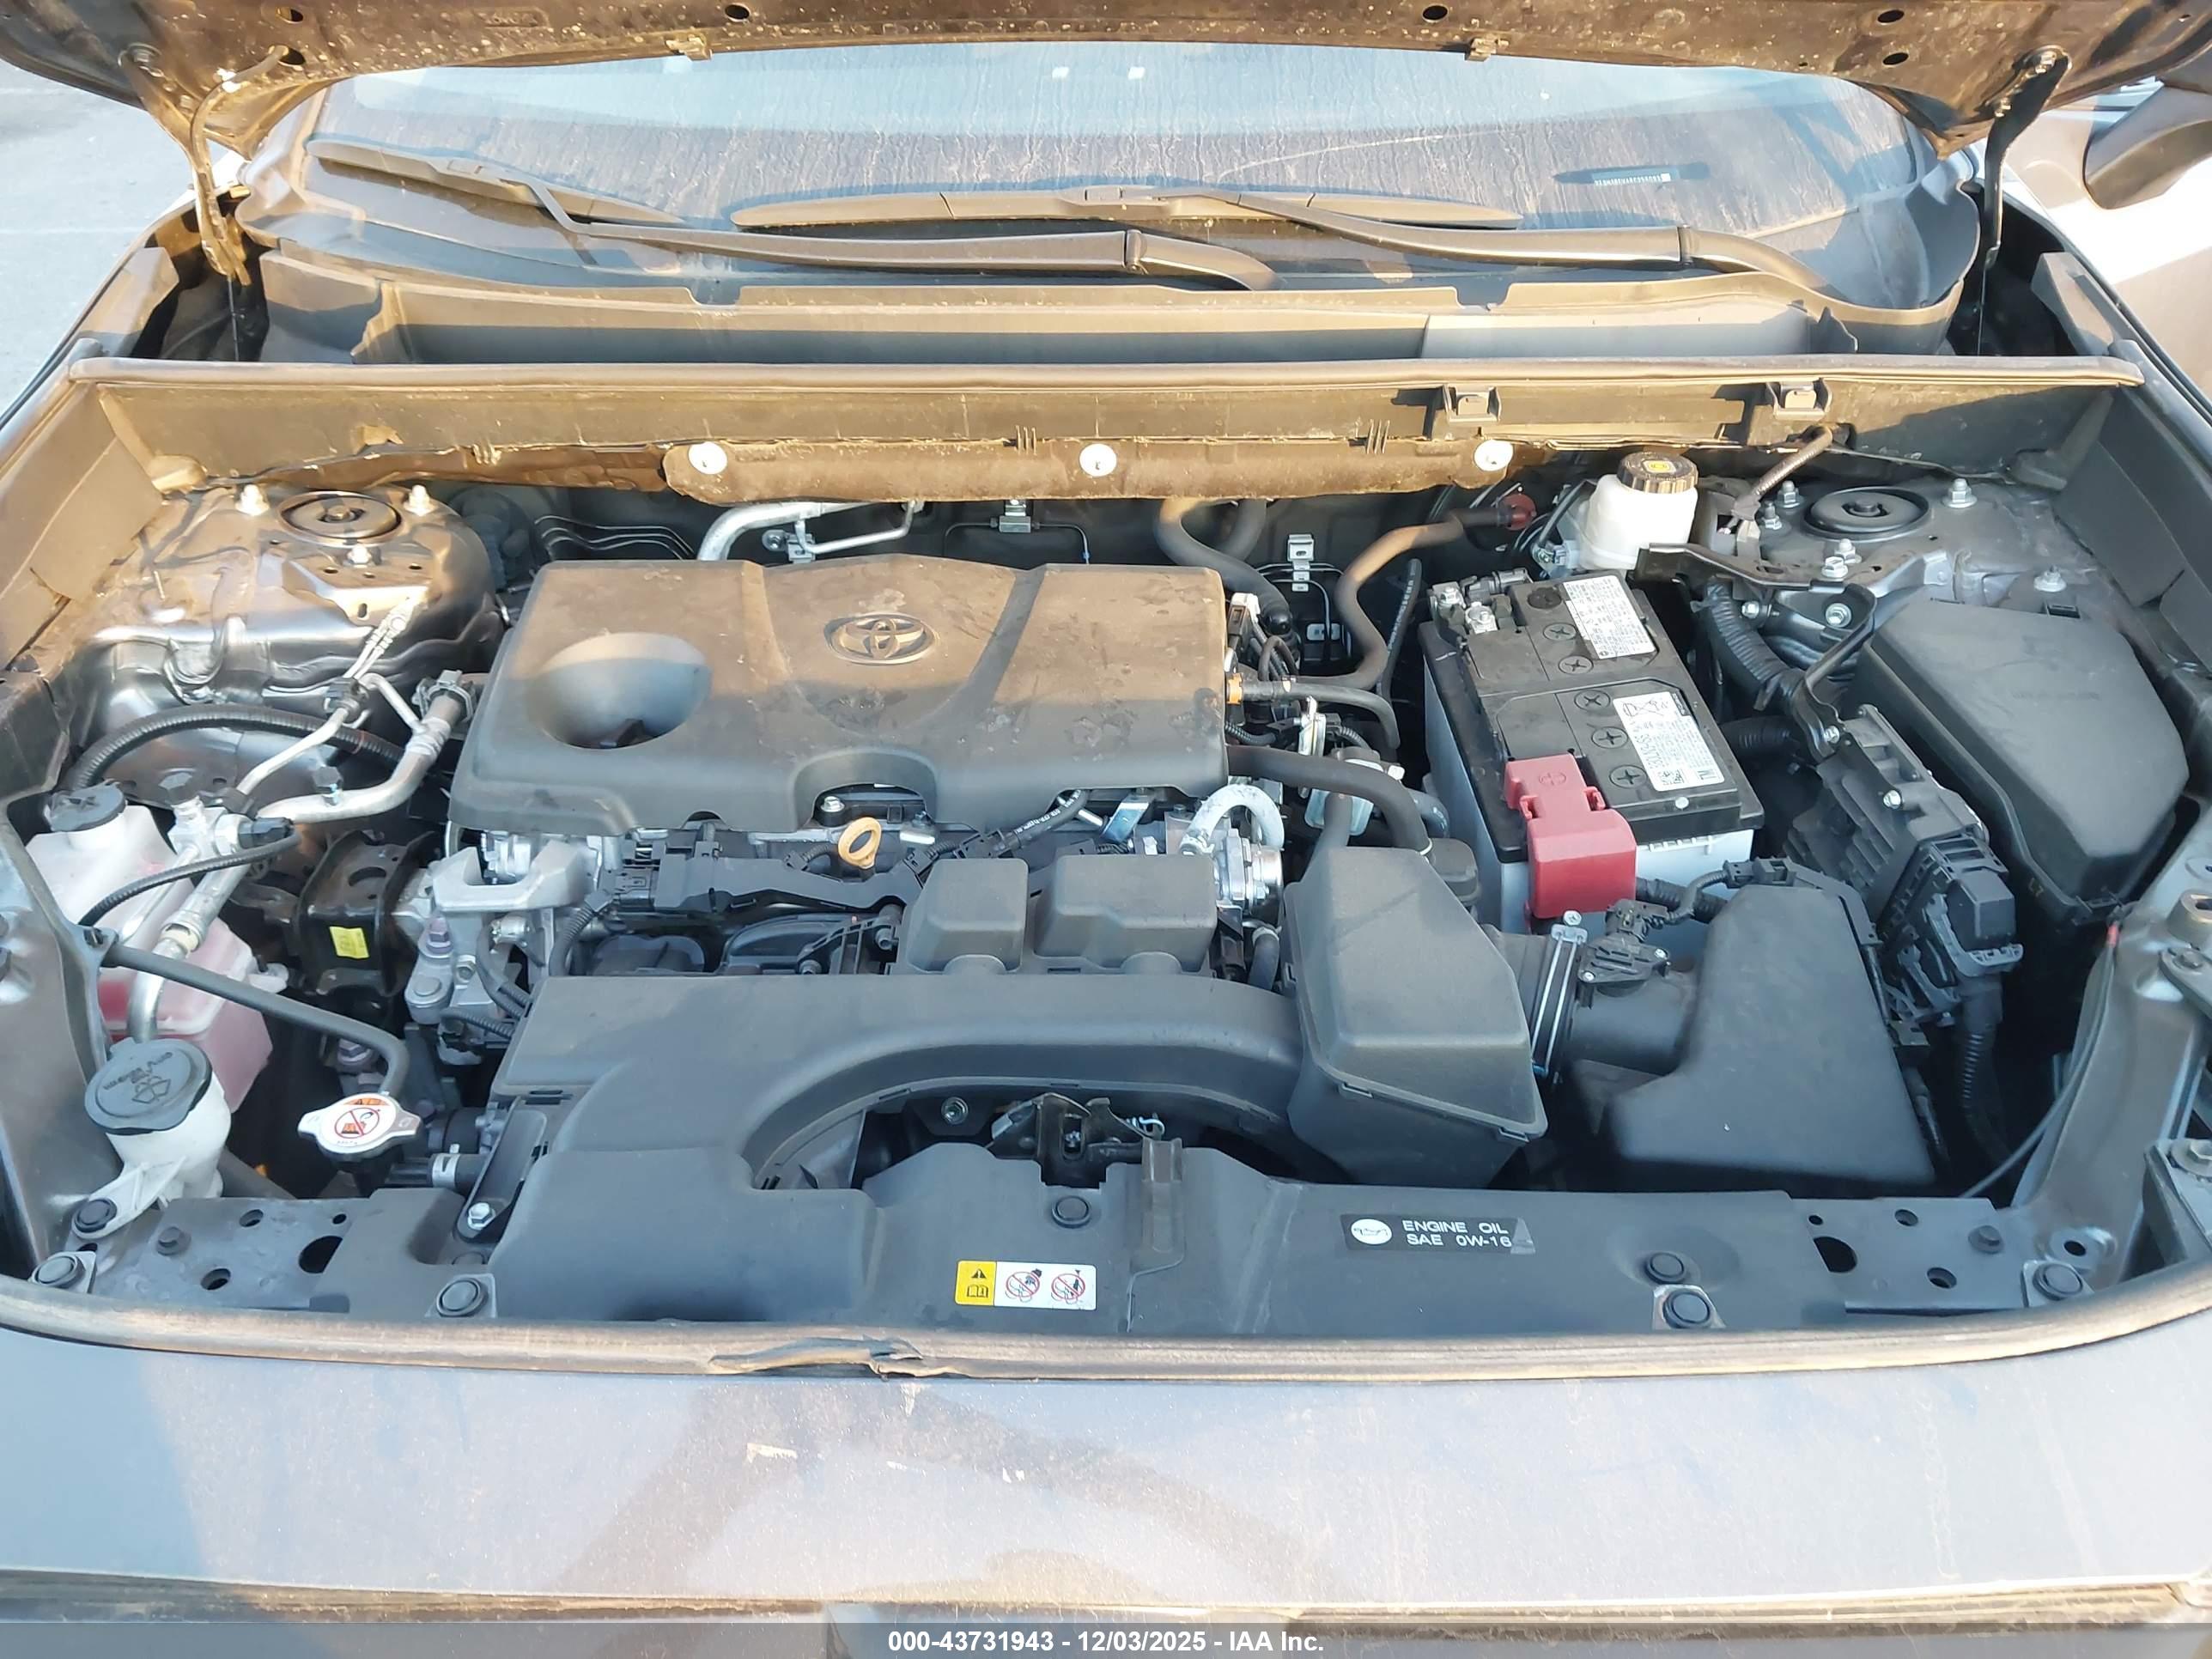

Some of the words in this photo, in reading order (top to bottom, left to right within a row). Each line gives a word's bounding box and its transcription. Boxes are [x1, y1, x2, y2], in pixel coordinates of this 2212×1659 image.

[1402, 1219, 1468, 1233] ENGINE
[1479, 1222, 1509, 1234] OIL
[1407, 1234, 1443, 1245] SAE
[1455, 1235, 1512, 1248] 0W-16
